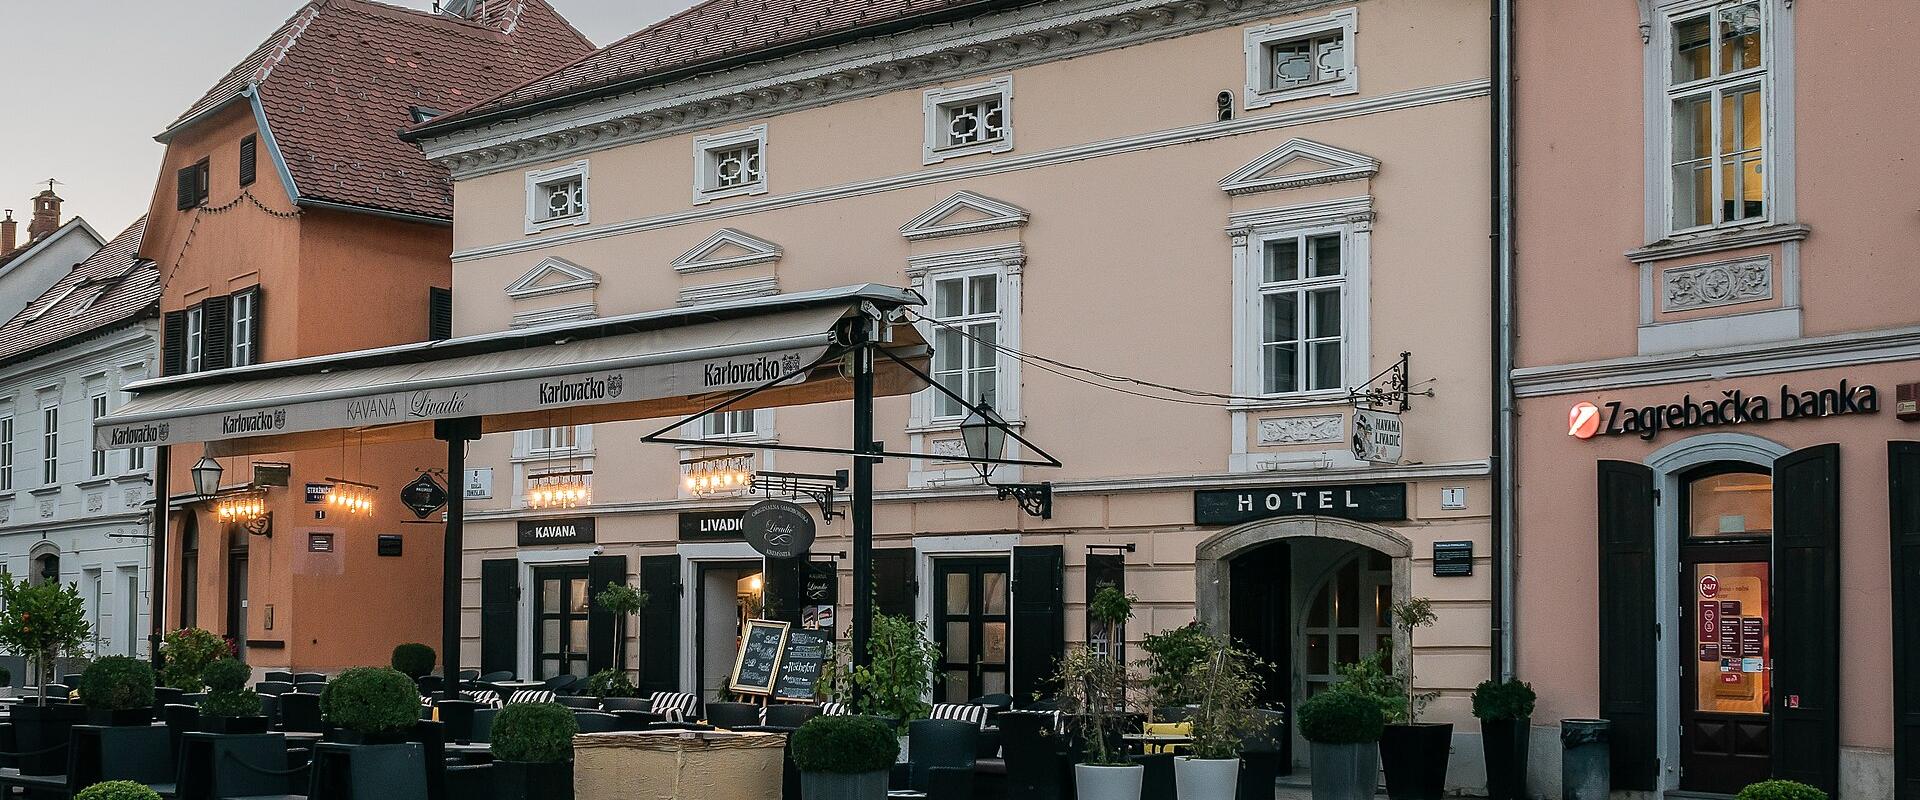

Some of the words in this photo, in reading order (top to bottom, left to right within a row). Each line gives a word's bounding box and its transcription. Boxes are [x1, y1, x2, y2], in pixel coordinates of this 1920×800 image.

[704, 356, 779, 386] Karlovačko
[540, 377, 604, 404] Karlovačko
[346, 398, 397, 420] KAVANA
[408, 390, 469, 417] Livadić
[1604, 390, 1768, 441] Zagrebačka
[1780, 379, 1878, 420] banka
[111, 423, 158, 446] Karlovačko
[223, 411, 273, 435] Karlovačko
[1375, 418, 1400, 433] HAVANA
[1238, 490, 1359, 512] HOTEL
[535, 525, 577, 538] KAVANA
[1702, 583, 1717, 591] 24/7
